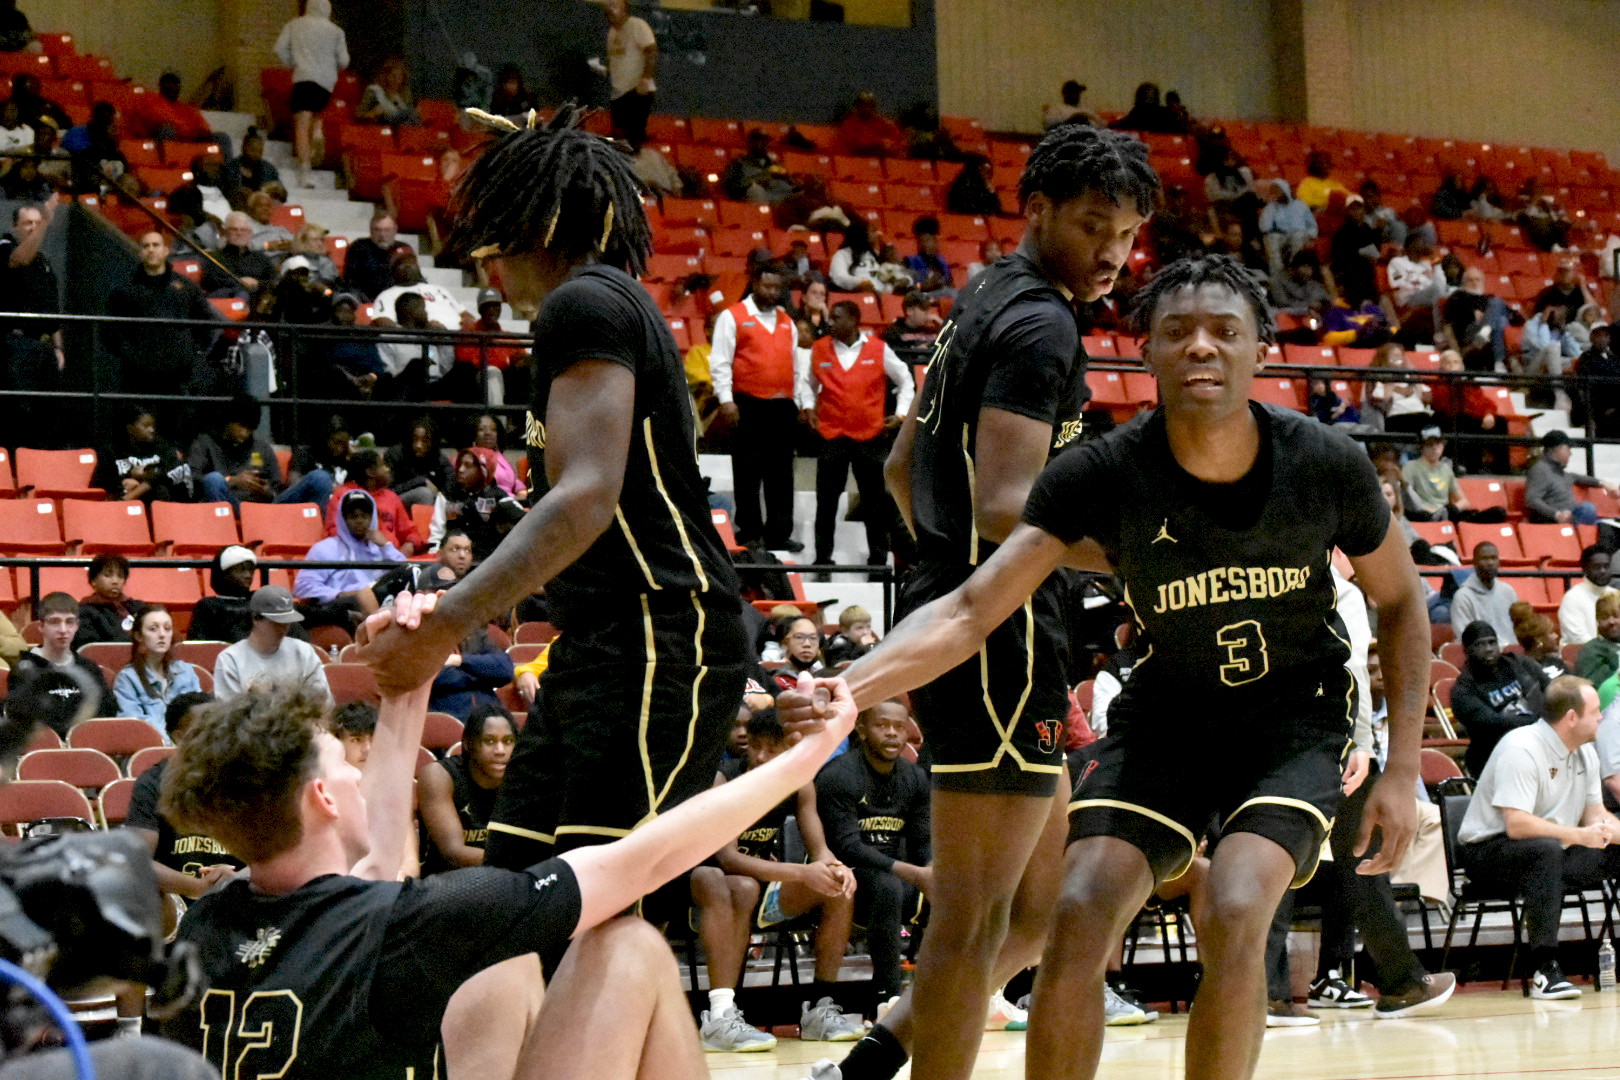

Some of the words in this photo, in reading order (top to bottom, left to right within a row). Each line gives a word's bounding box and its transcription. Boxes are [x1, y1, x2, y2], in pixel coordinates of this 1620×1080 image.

[1153, 565, 1311, 614] JONESBORO
[1216, 619, 1269, 687] 3
[200, 988, 304, 1080] 12
